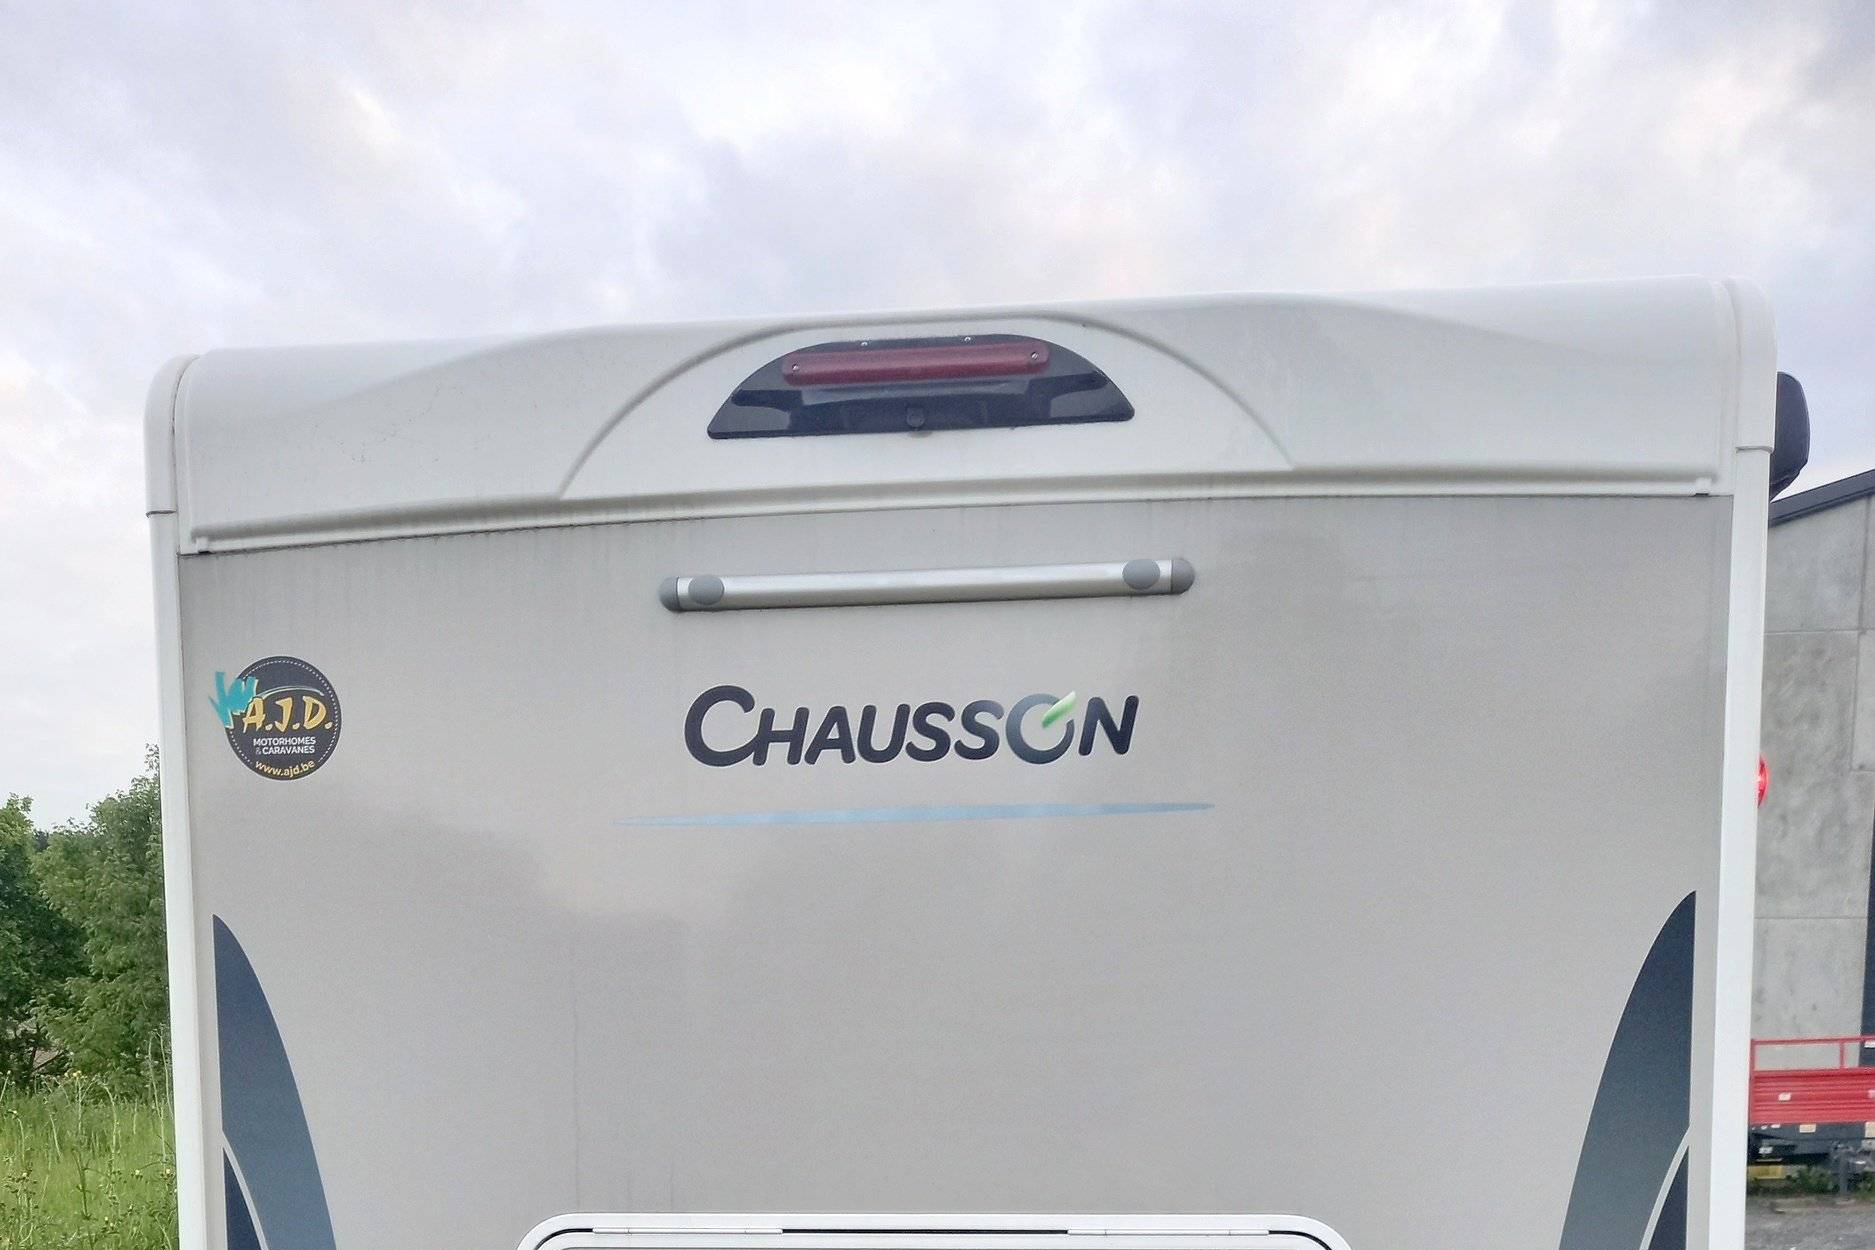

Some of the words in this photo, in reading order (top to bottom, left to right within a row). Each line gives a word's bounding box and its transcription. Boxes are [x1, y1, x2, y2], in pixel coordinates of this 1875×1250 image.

[242, 695, 333, 733] A.J.D.
[684, 684, 1139, 768] CHAUSSON
[253, 736, 317, 747] MOTORHOMES
[262, 745, 316, 755] CARAVANES
[254, 759, 316, 778] www.ajd.be
